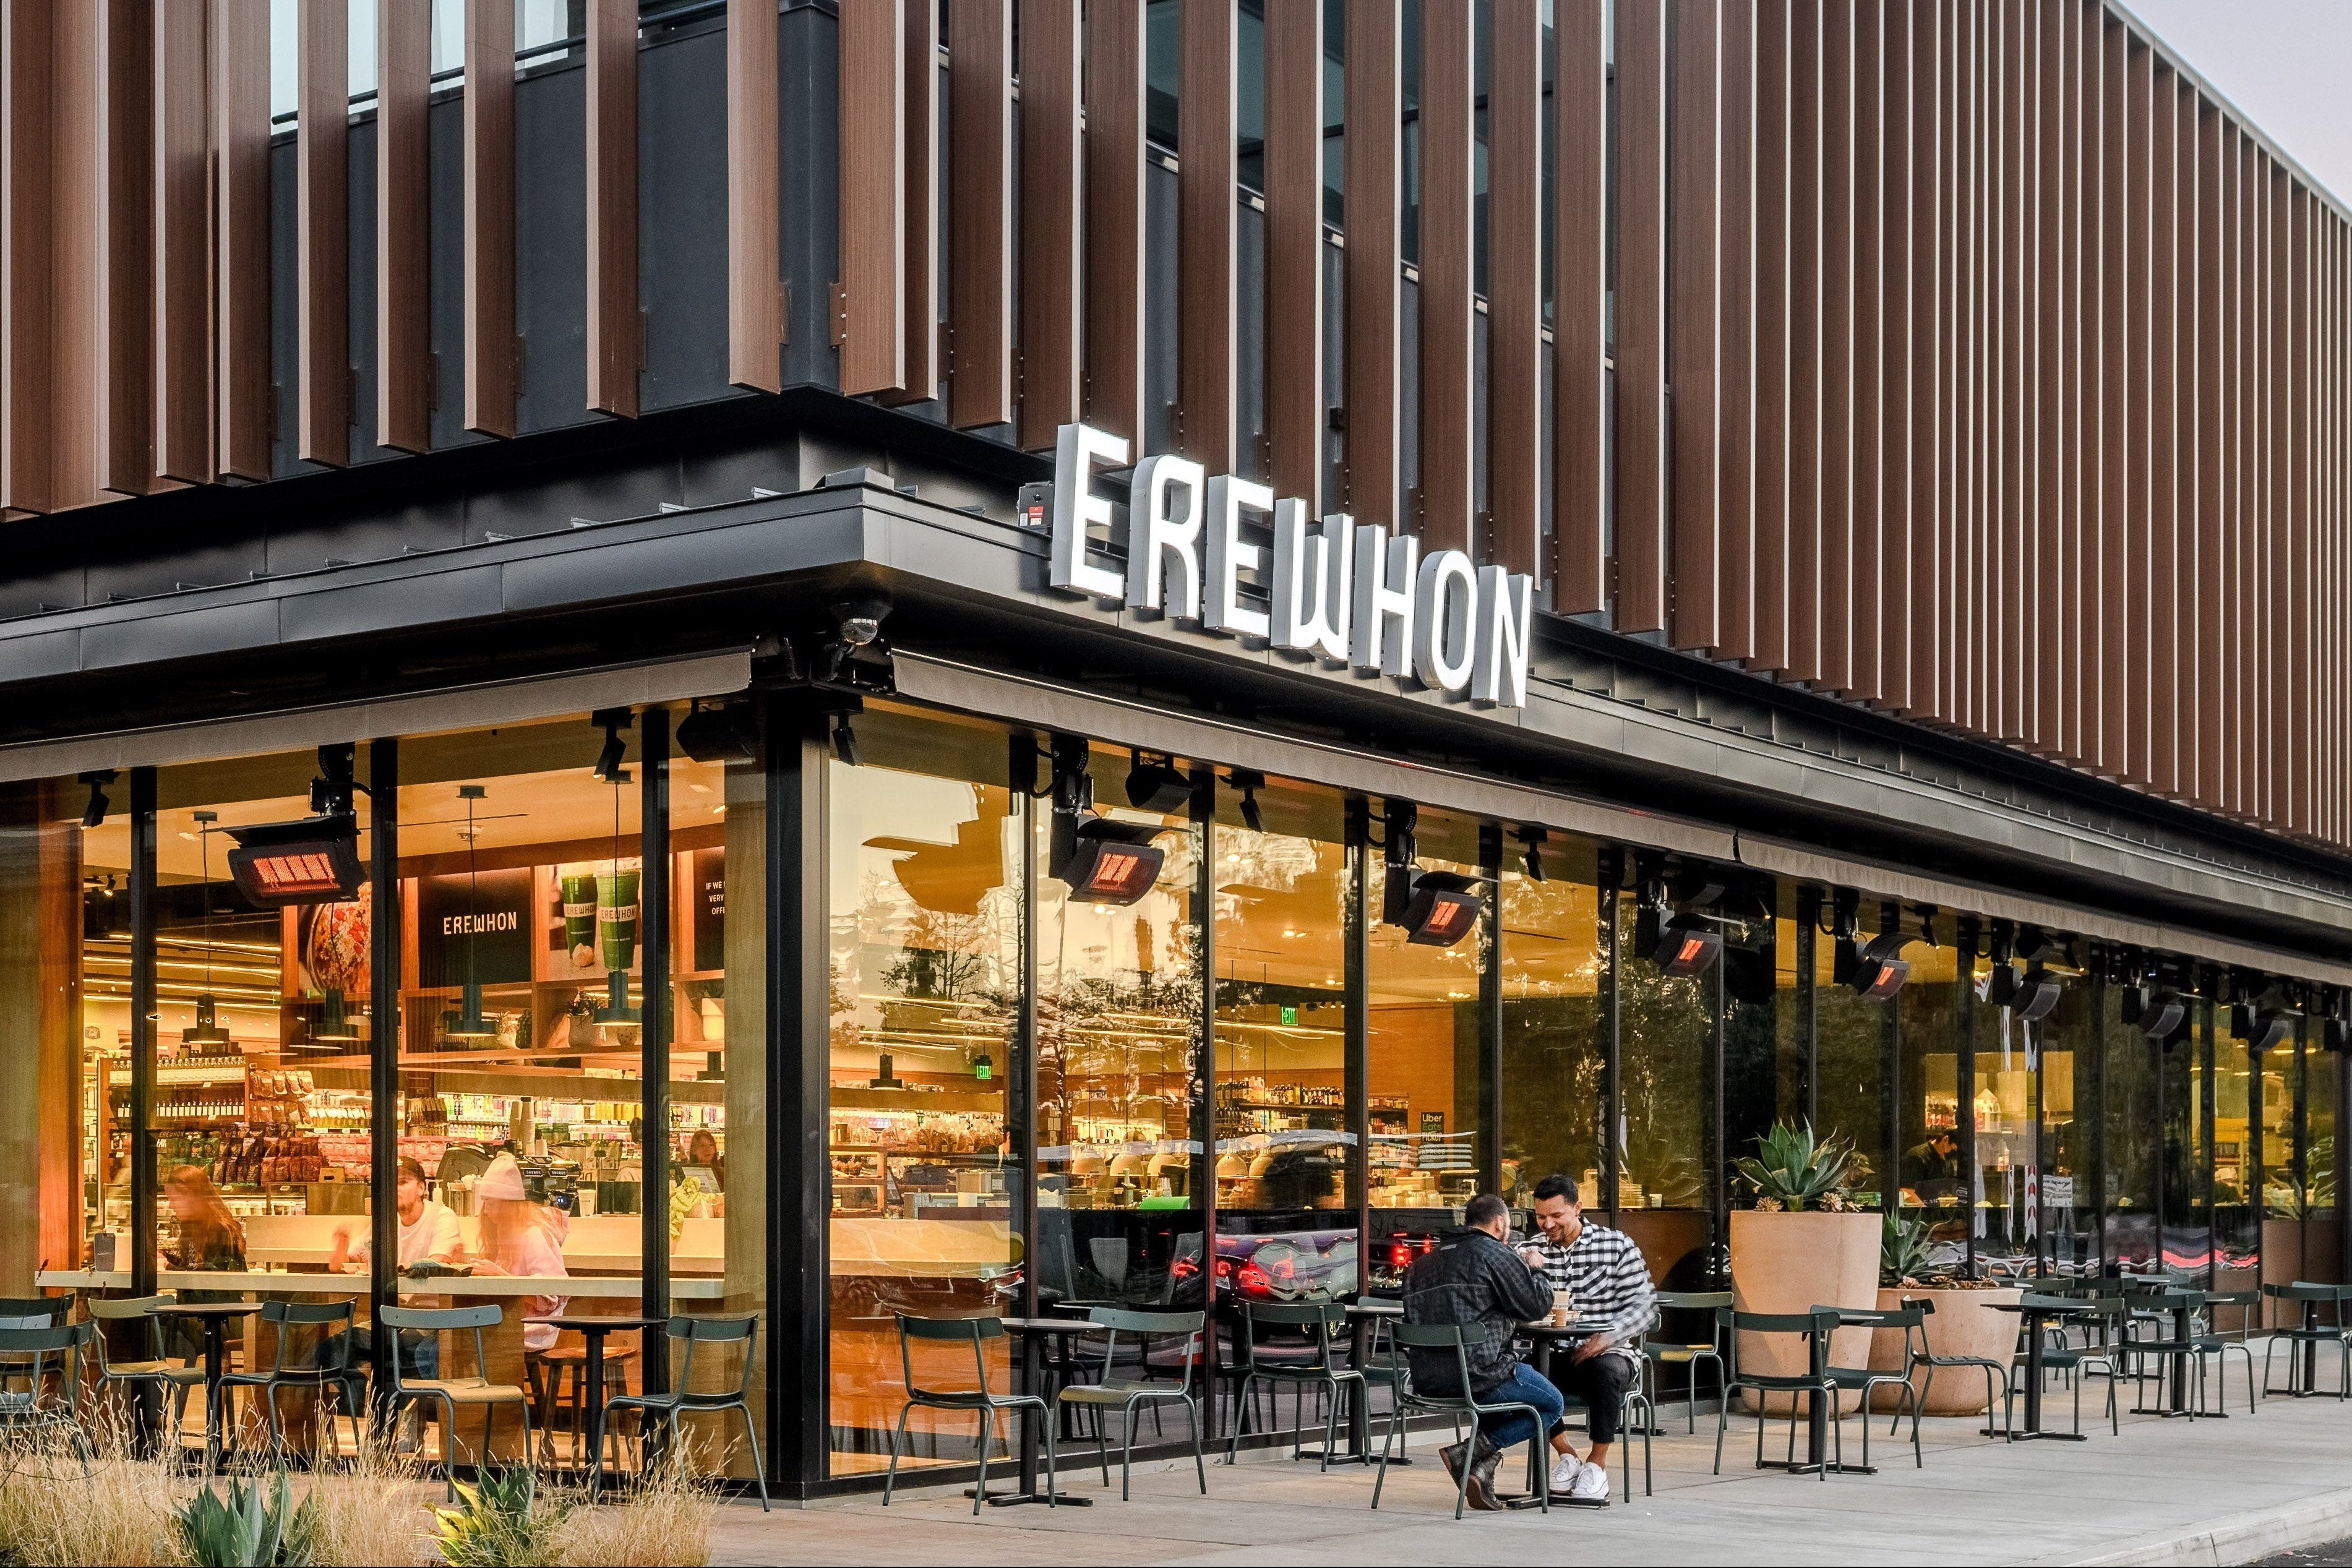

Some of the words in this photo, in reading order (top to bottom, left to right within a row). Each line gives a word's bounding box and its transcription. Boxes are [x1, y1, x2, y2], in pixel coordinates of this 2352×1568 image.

[1050, 422, 1534, 709] EREWHON
[444, 911, 517, 935] EREWHON
[1422, 1114, 1443, 1122] Uber
[1422, 1123, 1442, 1131] Eats
